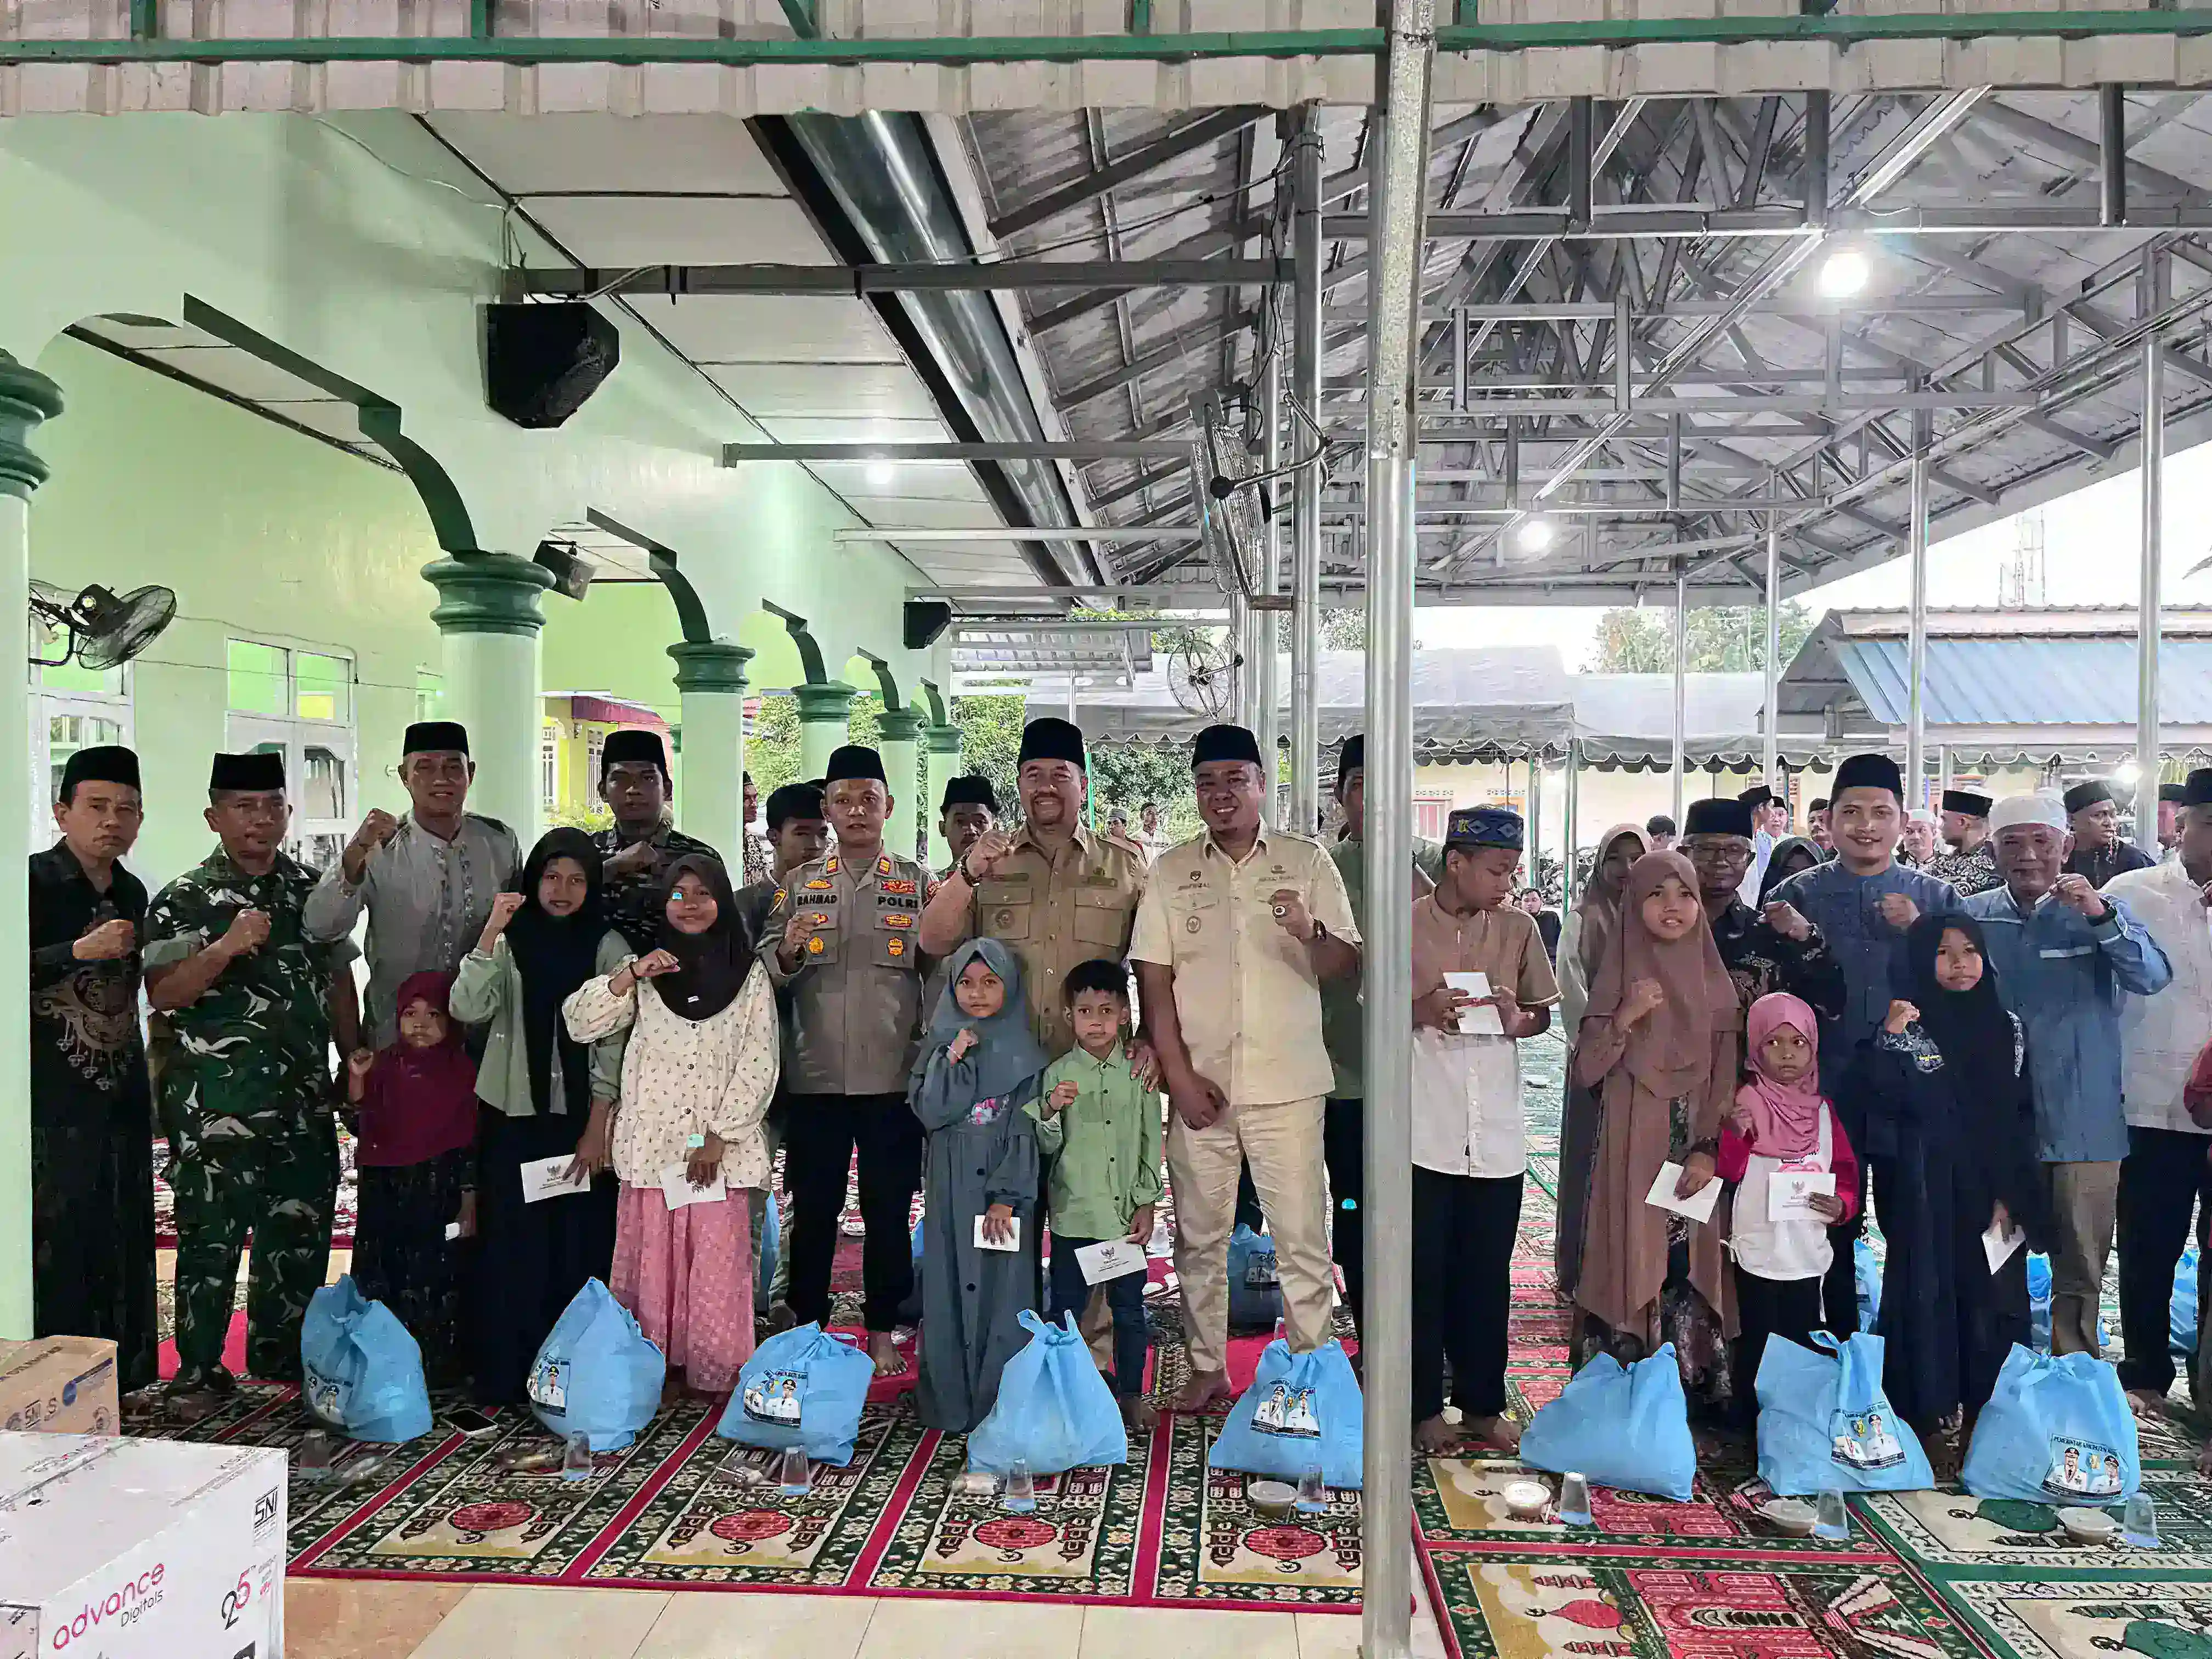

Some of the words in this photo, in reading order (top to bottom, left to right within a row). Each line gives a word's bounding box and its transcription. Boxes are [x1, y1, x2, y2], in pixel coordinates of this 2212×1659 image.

[797, 894, 837, 906] RAHMAD
[878, 896, 918, 908] POLRI
[254, 1489, 278, 1526] SNI
[53, 1563, 165, 1650] advance
[121, 1589, 163, 1628] Digitals
